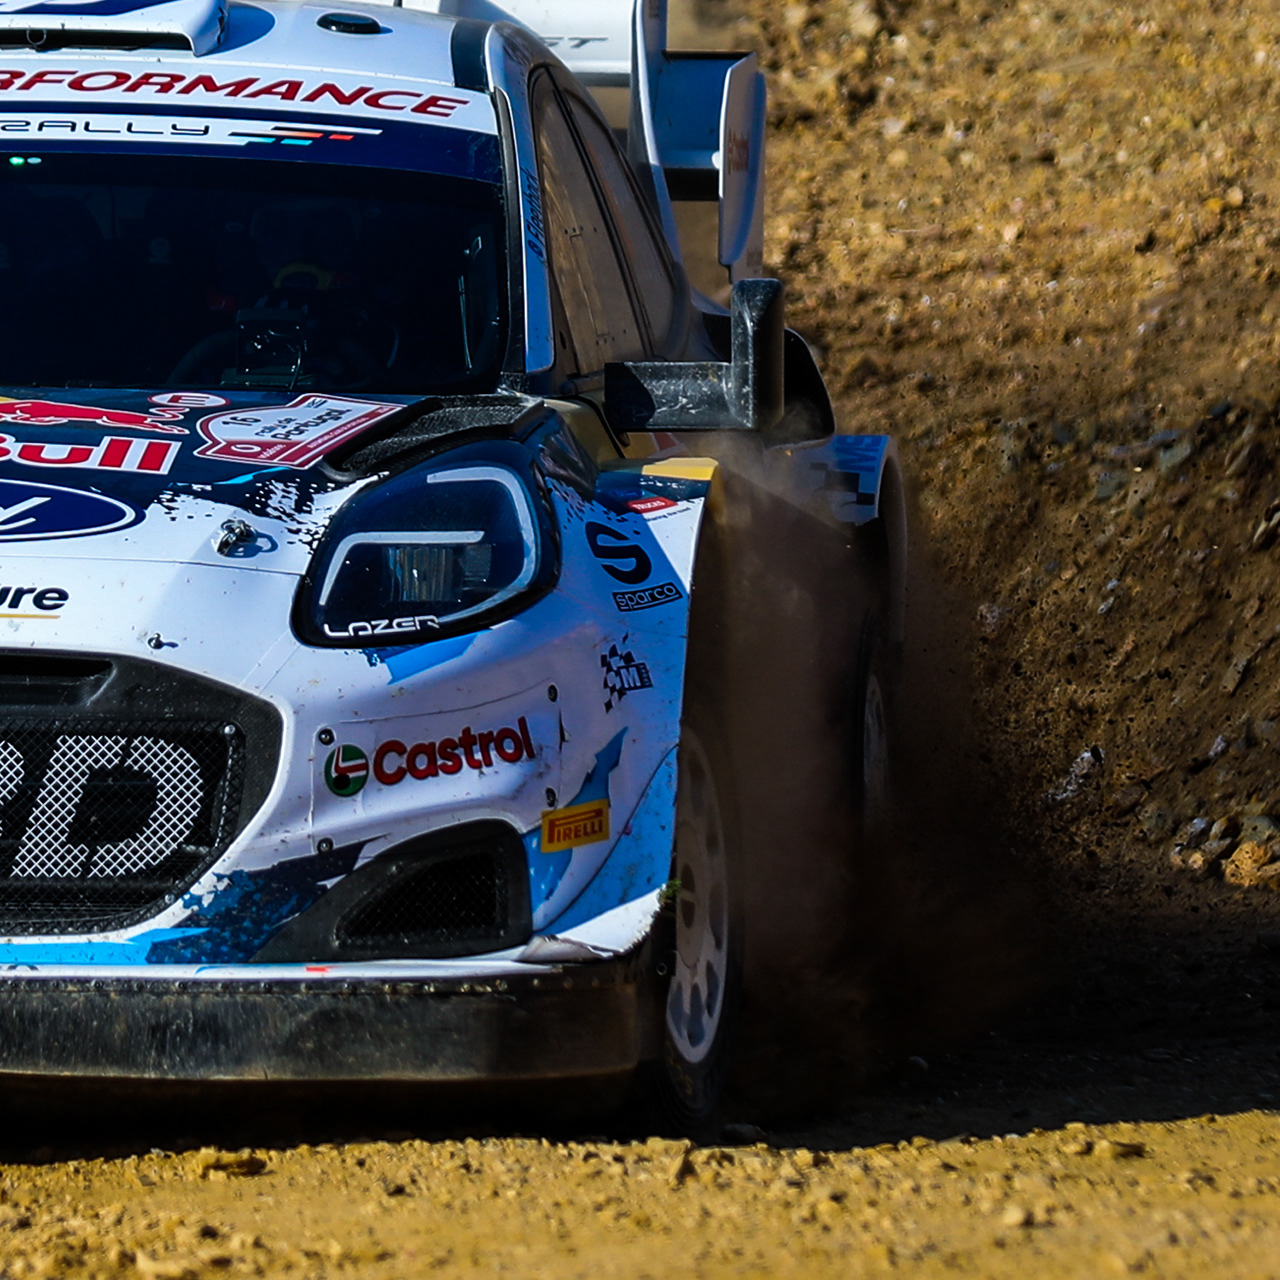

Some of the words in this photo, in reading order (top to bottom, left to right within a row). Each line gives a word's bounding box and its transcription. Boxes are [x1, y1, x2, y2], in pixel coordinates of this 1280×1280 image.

[221, 416, 262, 427] 16
[616, 584, 678, 610] sparco
[323, 615, 440, 638] LAZER
[373, 716, 536, 786] Castrol
[547, 807, 605, 844] PIRELLI
